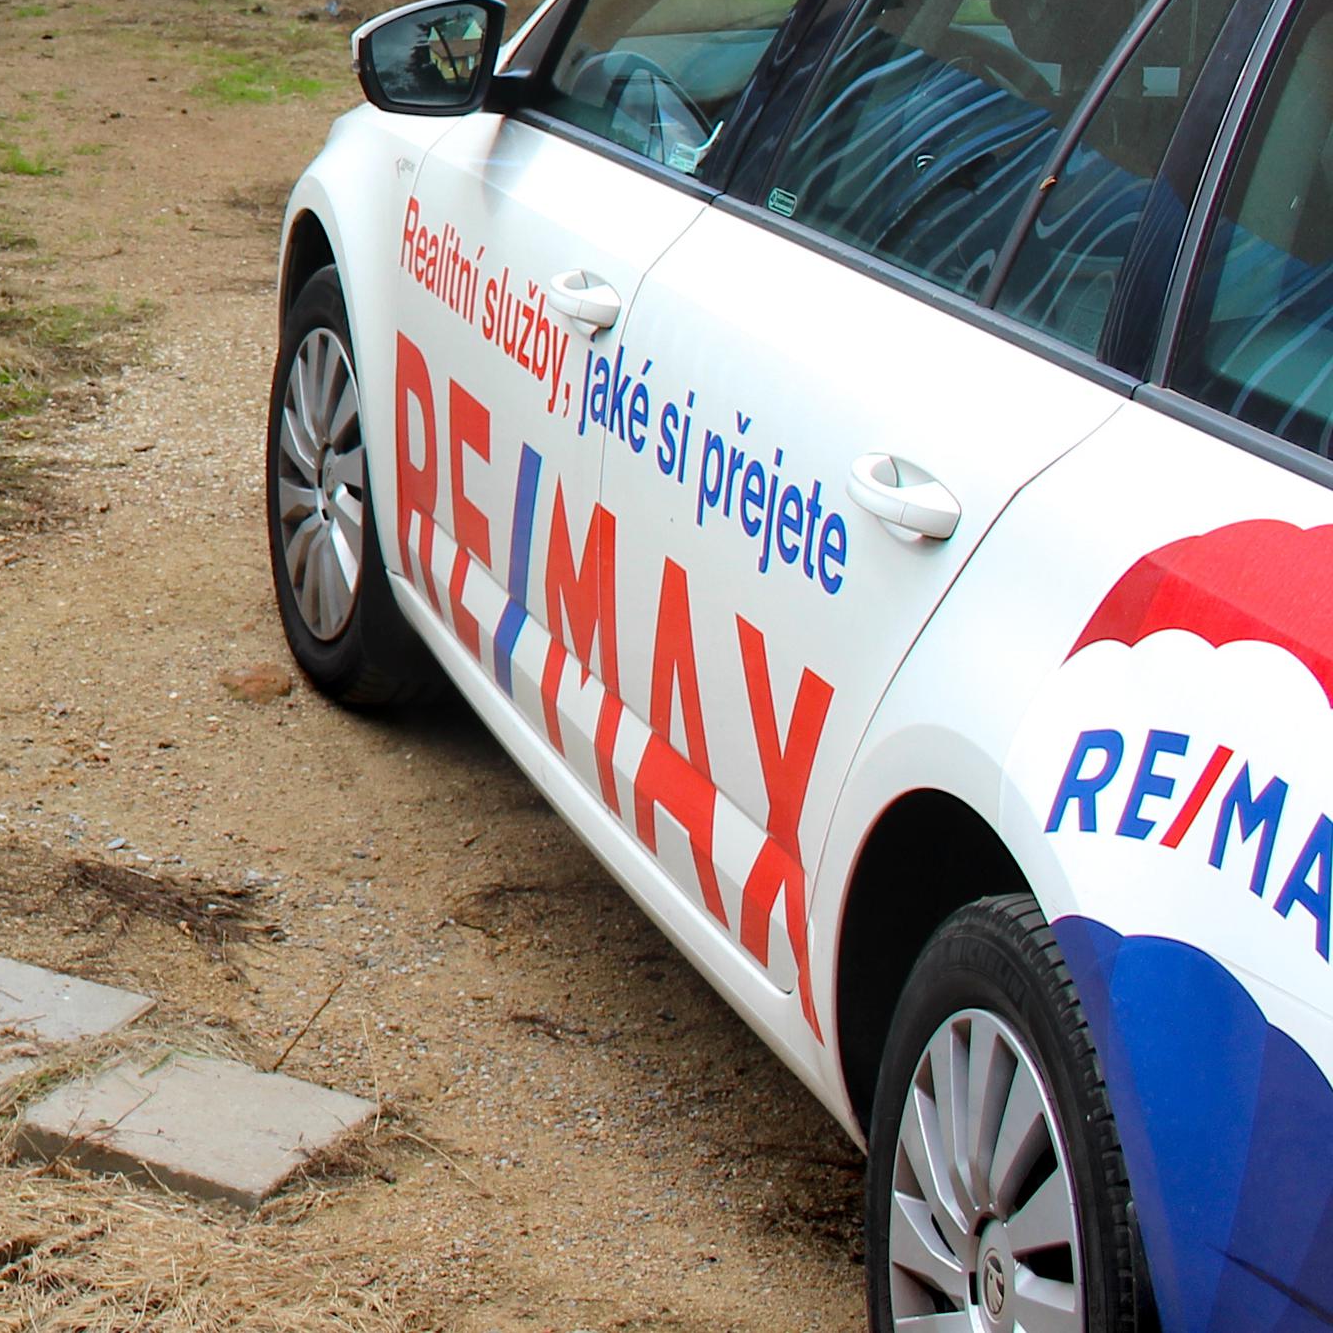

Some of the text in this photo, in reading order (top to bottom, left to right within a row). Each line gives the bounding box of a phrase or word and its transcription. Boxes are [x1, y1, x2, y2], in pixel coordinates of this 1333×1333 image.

[399, 196, 848, 595] Realitní služby, jaké si přejete
[396, 330, 835, 1047] RE/MAX
